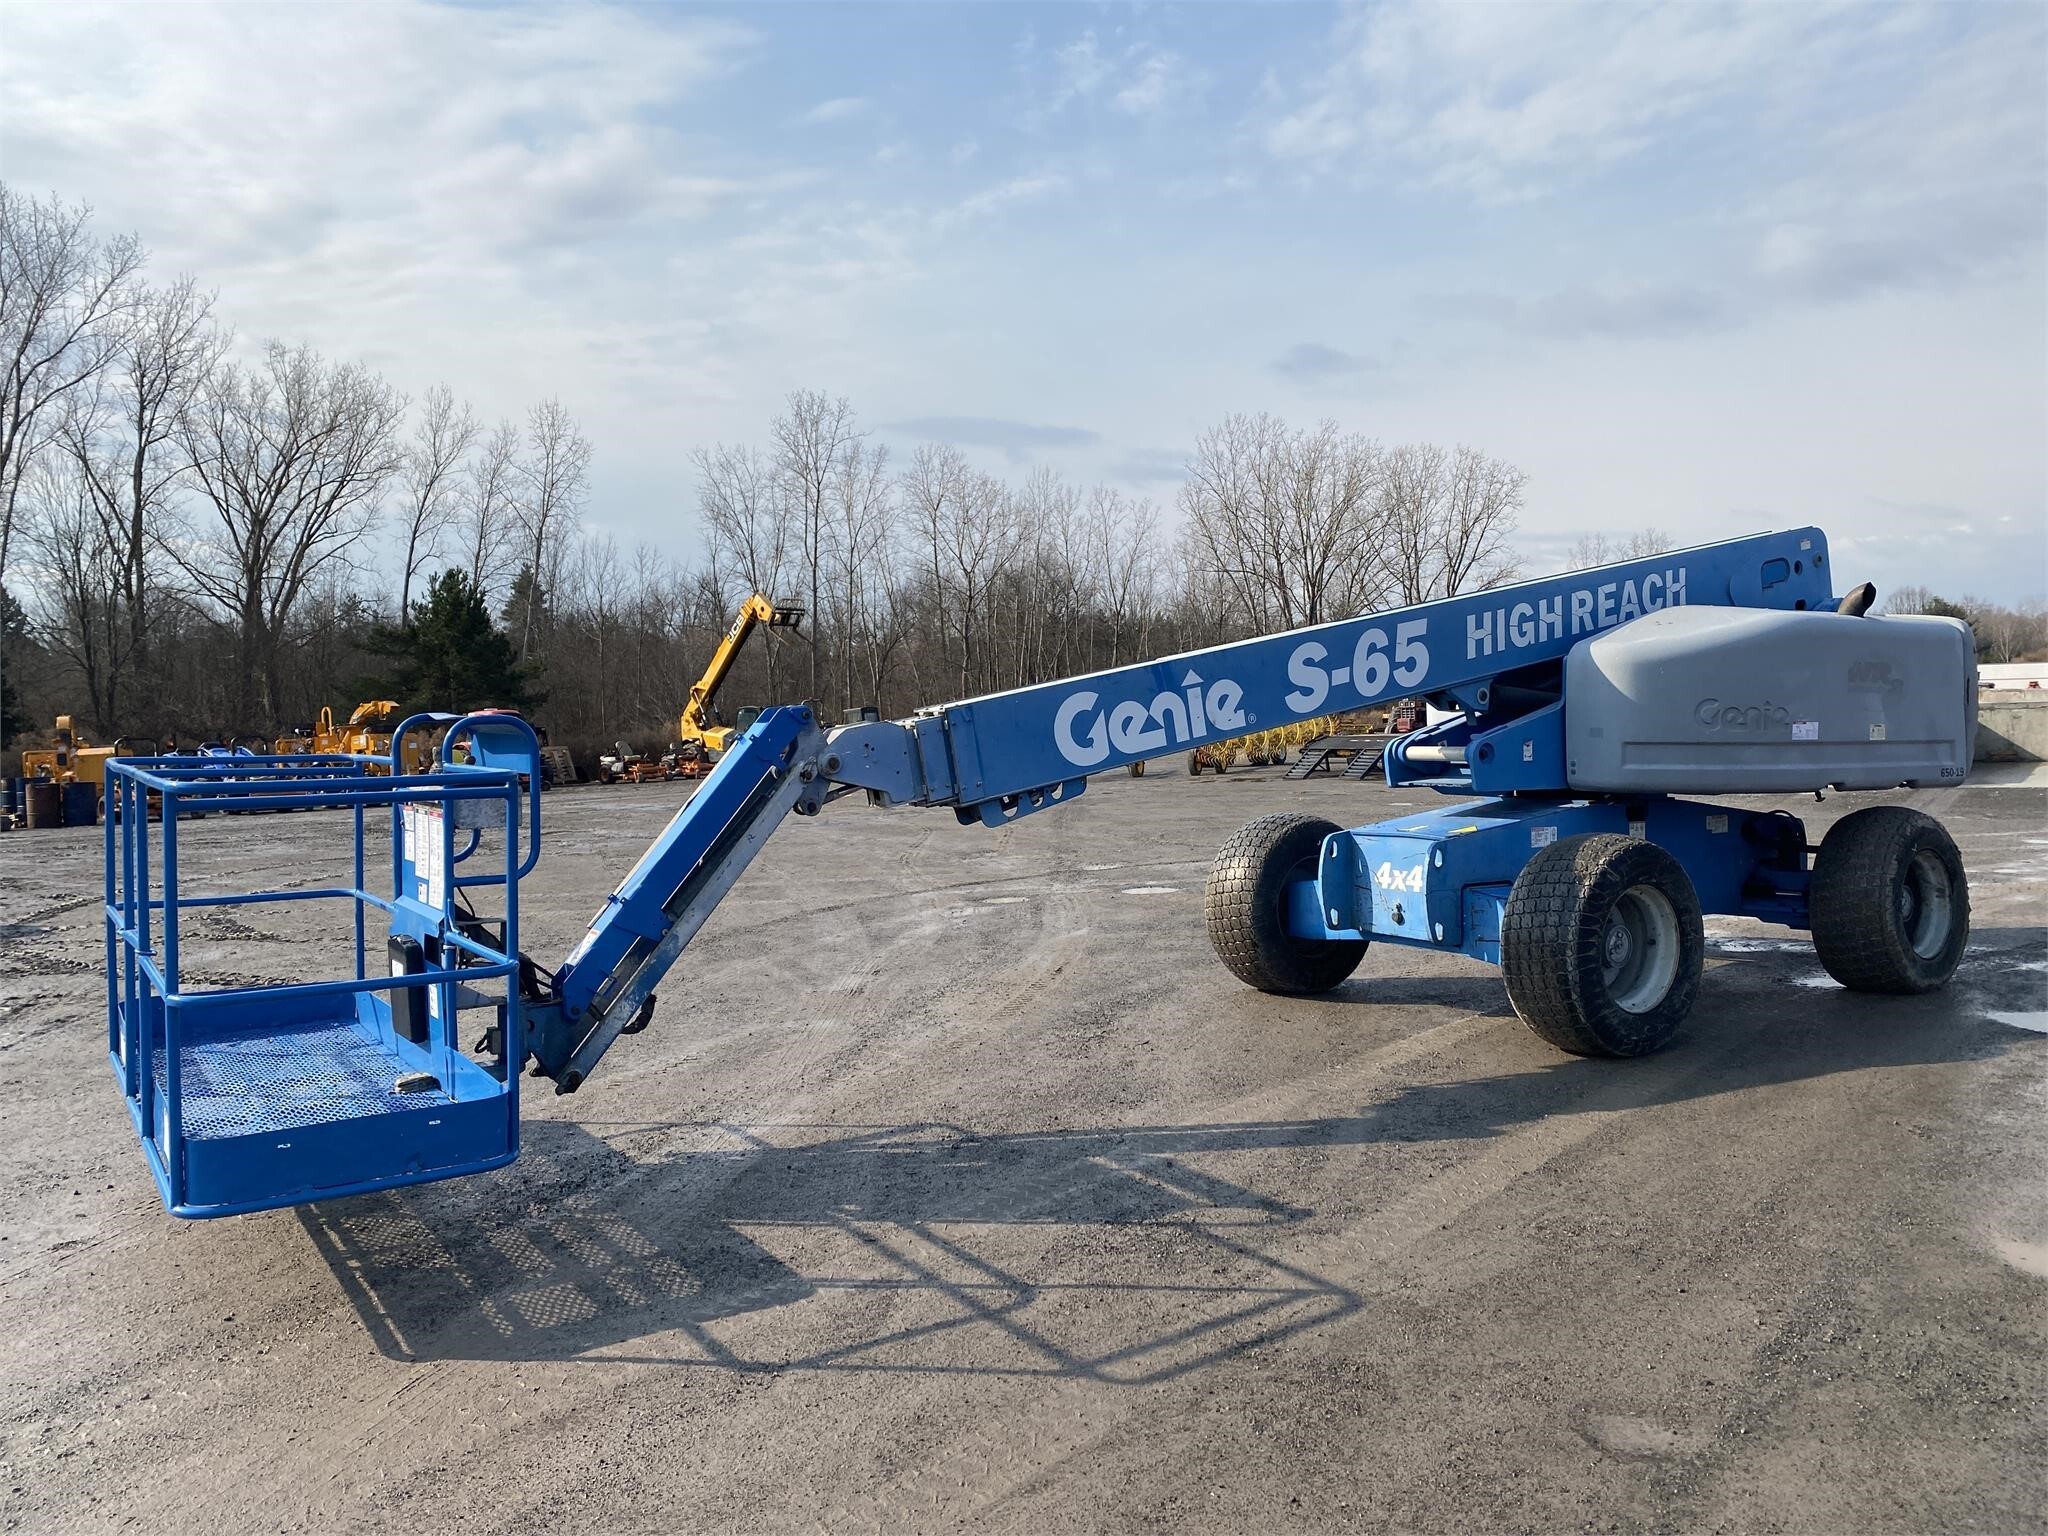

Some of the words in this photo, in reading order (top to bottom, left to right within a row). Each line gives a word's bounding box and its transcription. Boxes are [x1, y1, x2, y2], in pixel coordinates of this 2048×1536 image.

[727, 614, 745, 642] JCB
[1054, 669, 1246, 767] Genie
[1285, 618, 1430, 713] S-65
[1694, 697, 1791, 732] Genie
[1375, 861, 1423, 893] 4x4
